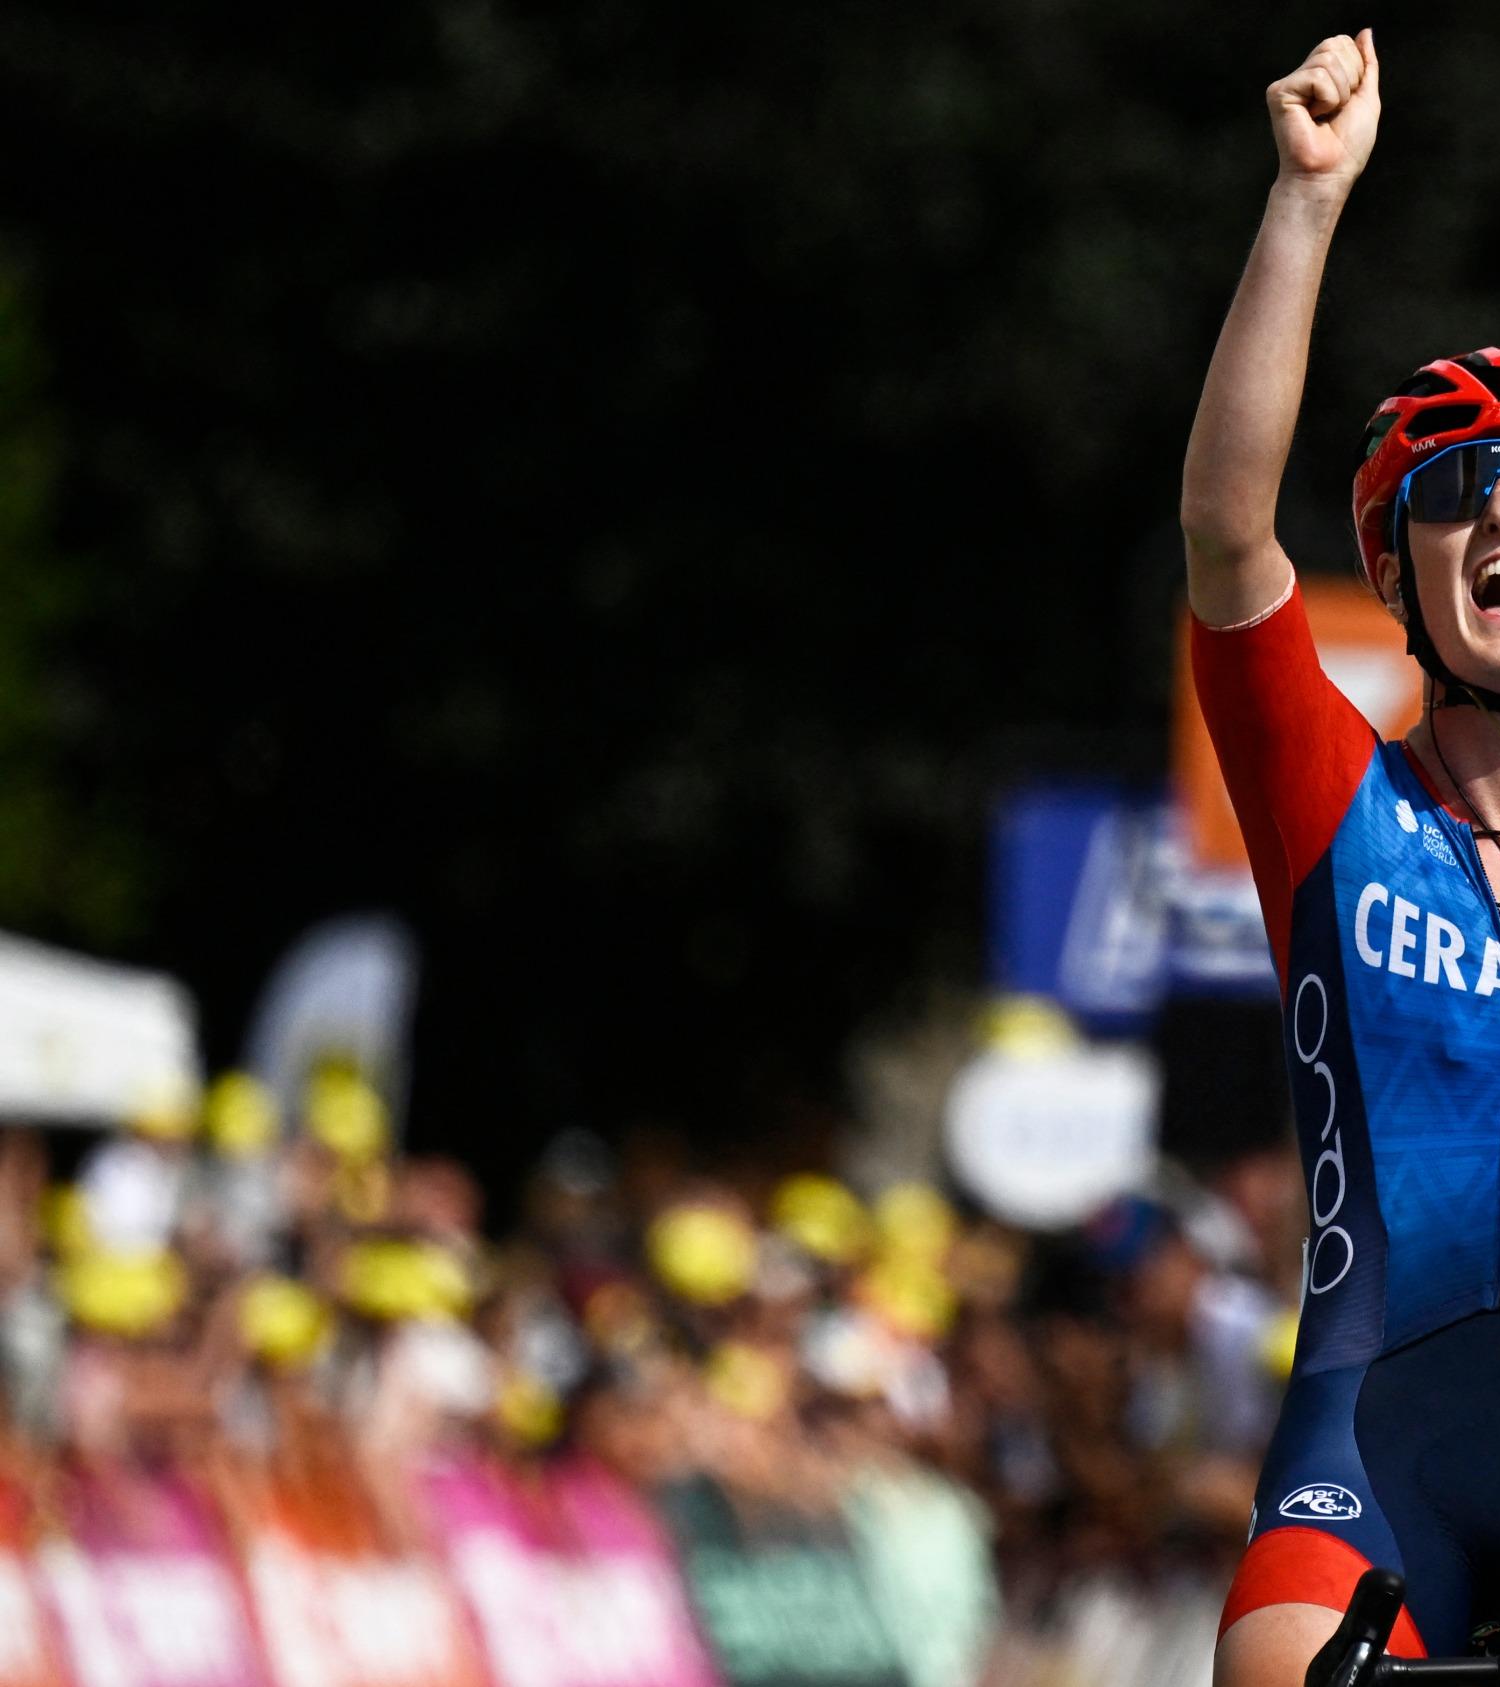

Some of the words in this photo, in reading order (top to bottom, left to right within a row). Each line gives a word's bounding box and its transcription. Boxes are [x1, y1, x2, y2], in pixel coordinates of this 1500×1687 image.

[1411, 438, 1437, 453] KASK
[1423, 824, 1443, 841] UCI
[1423, 841, 1460, 869] WORLD
